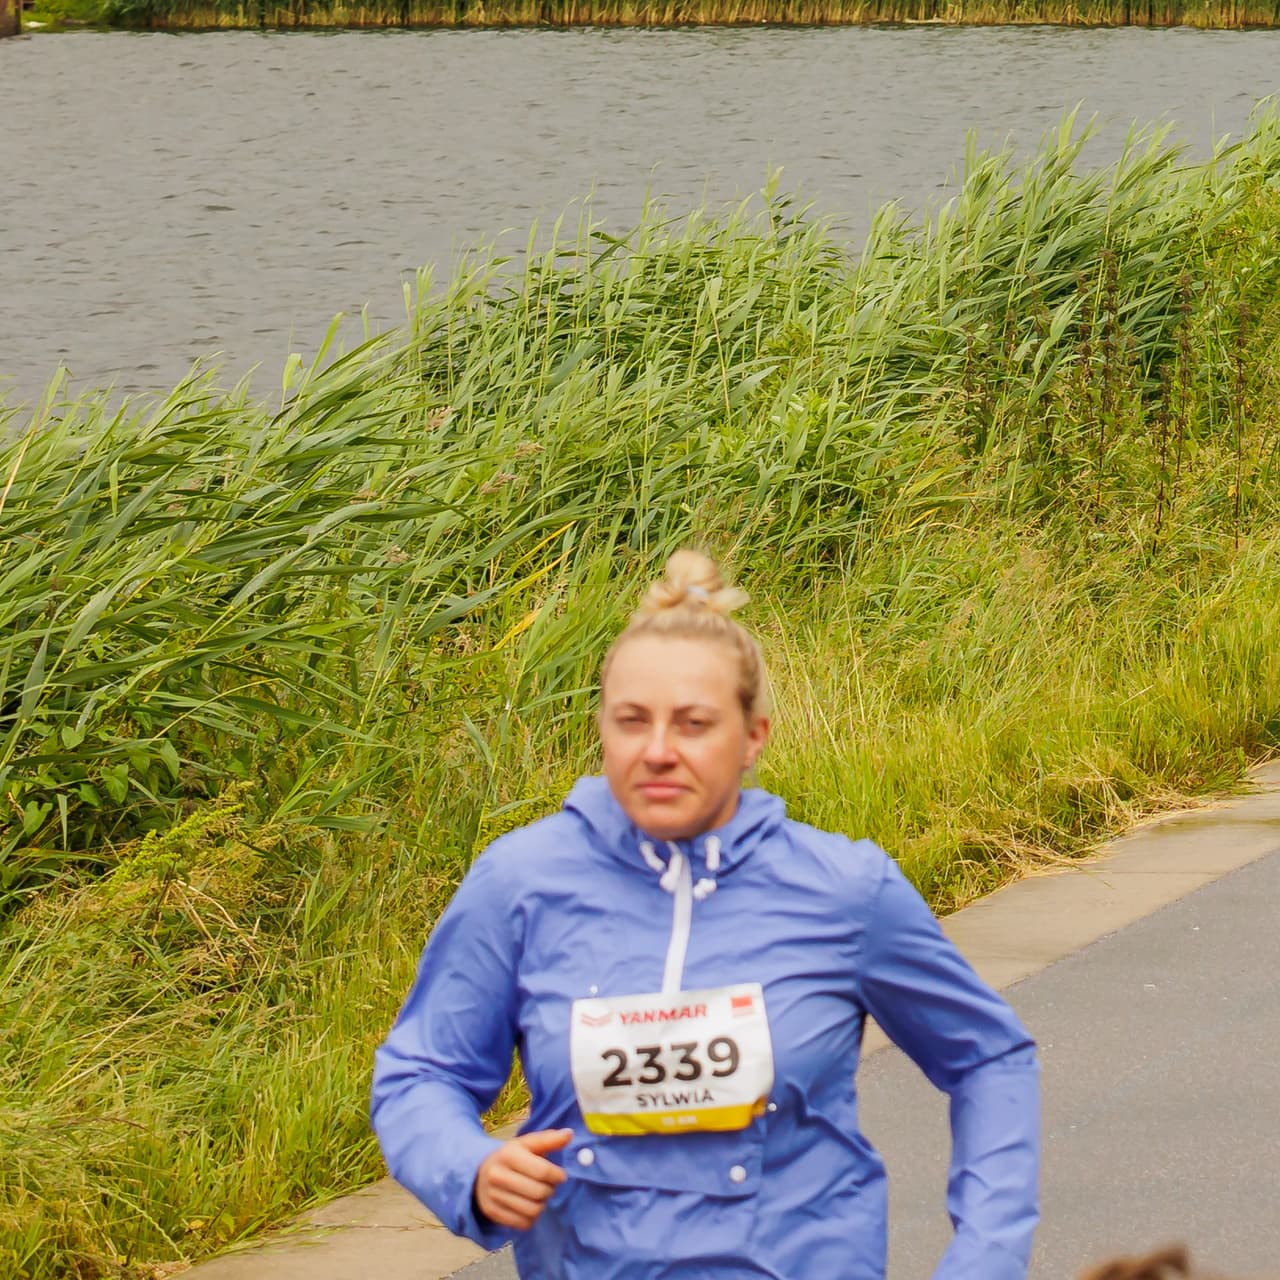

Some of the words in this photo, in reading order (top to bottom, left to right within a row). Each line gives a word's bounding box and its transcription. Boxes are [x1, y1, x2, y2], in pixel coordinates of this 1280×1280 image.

[619, 1004, 708, 1025] YANMAR
[601, 1035, 740, 1087] 2339
[636, 1088, 715, 1108] SYLWIA
